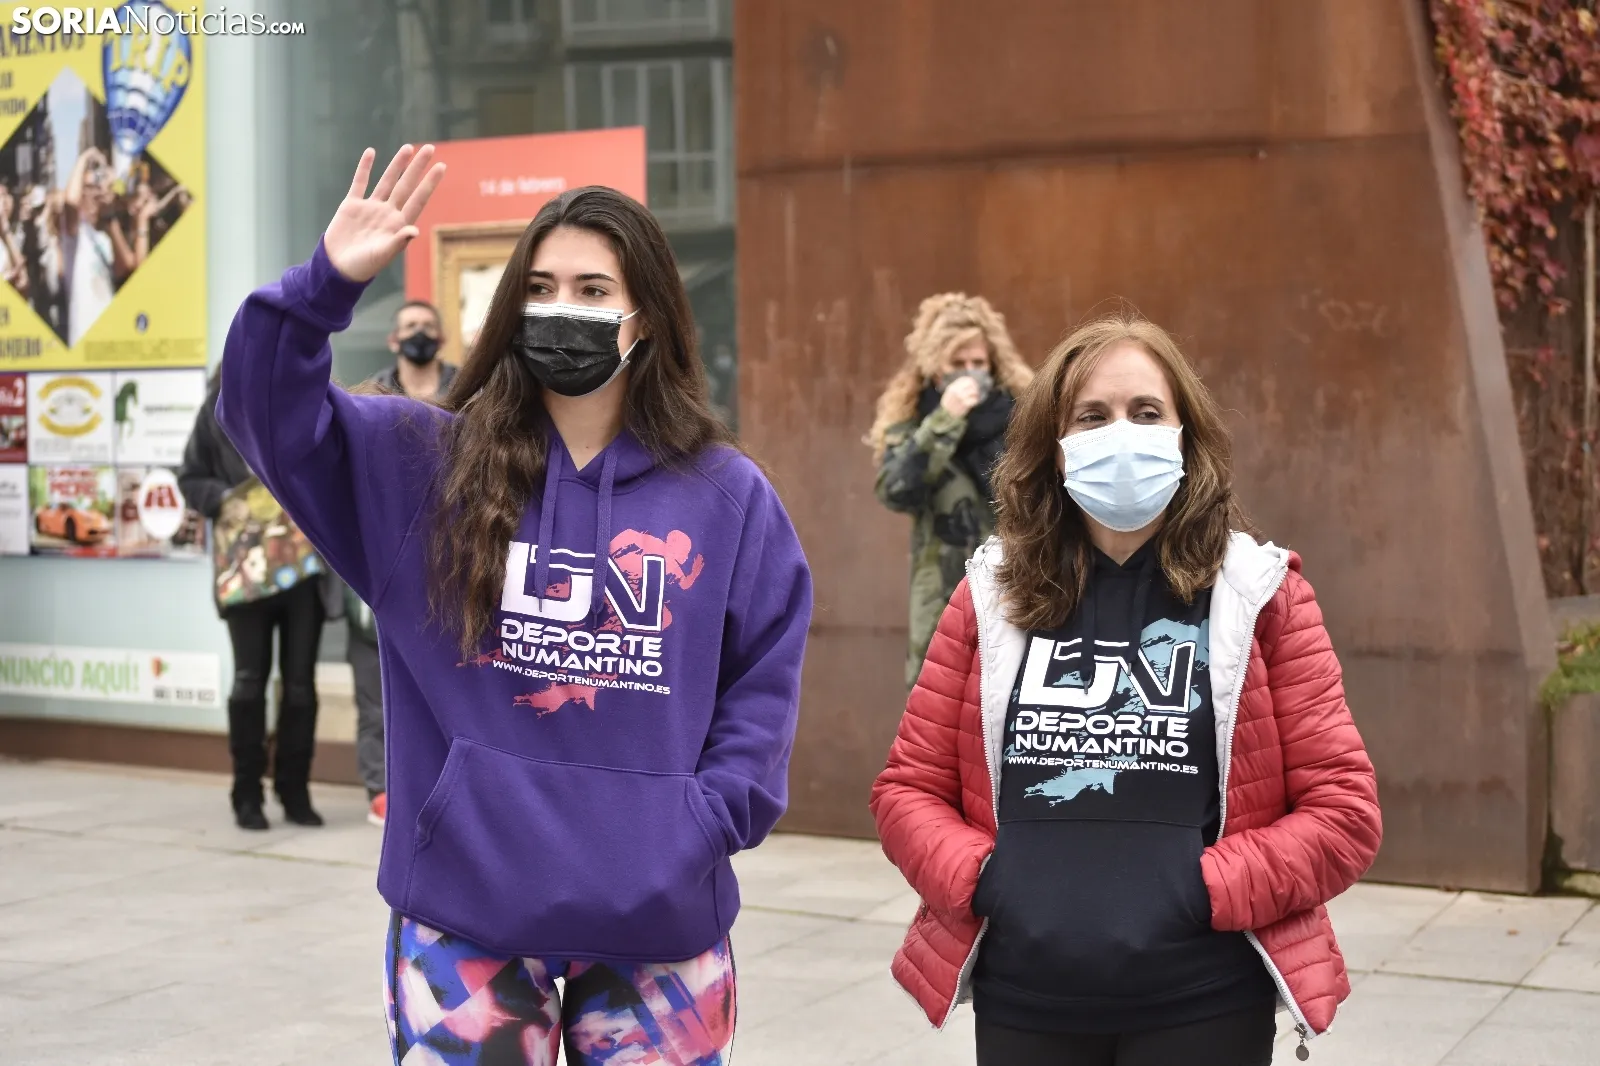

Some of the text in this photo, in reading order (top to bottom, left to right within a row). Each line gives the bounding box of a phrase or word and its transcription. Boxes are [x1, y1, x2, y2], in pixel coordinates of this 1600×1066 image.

[501, 618, 663, 658] DEPORTE
[502, 641, 663, 677] NUMANTINO
[492, 659, 671, 695] WWW.DEPORTENUMANTINO.ES
[1015, 710, 1190, 738] DEPORTE
[1015, 733, 1189, 757] NUMANTINO
[1008, 756, 1199, 774] WWW.DEPORTENUMANTINO.ES
